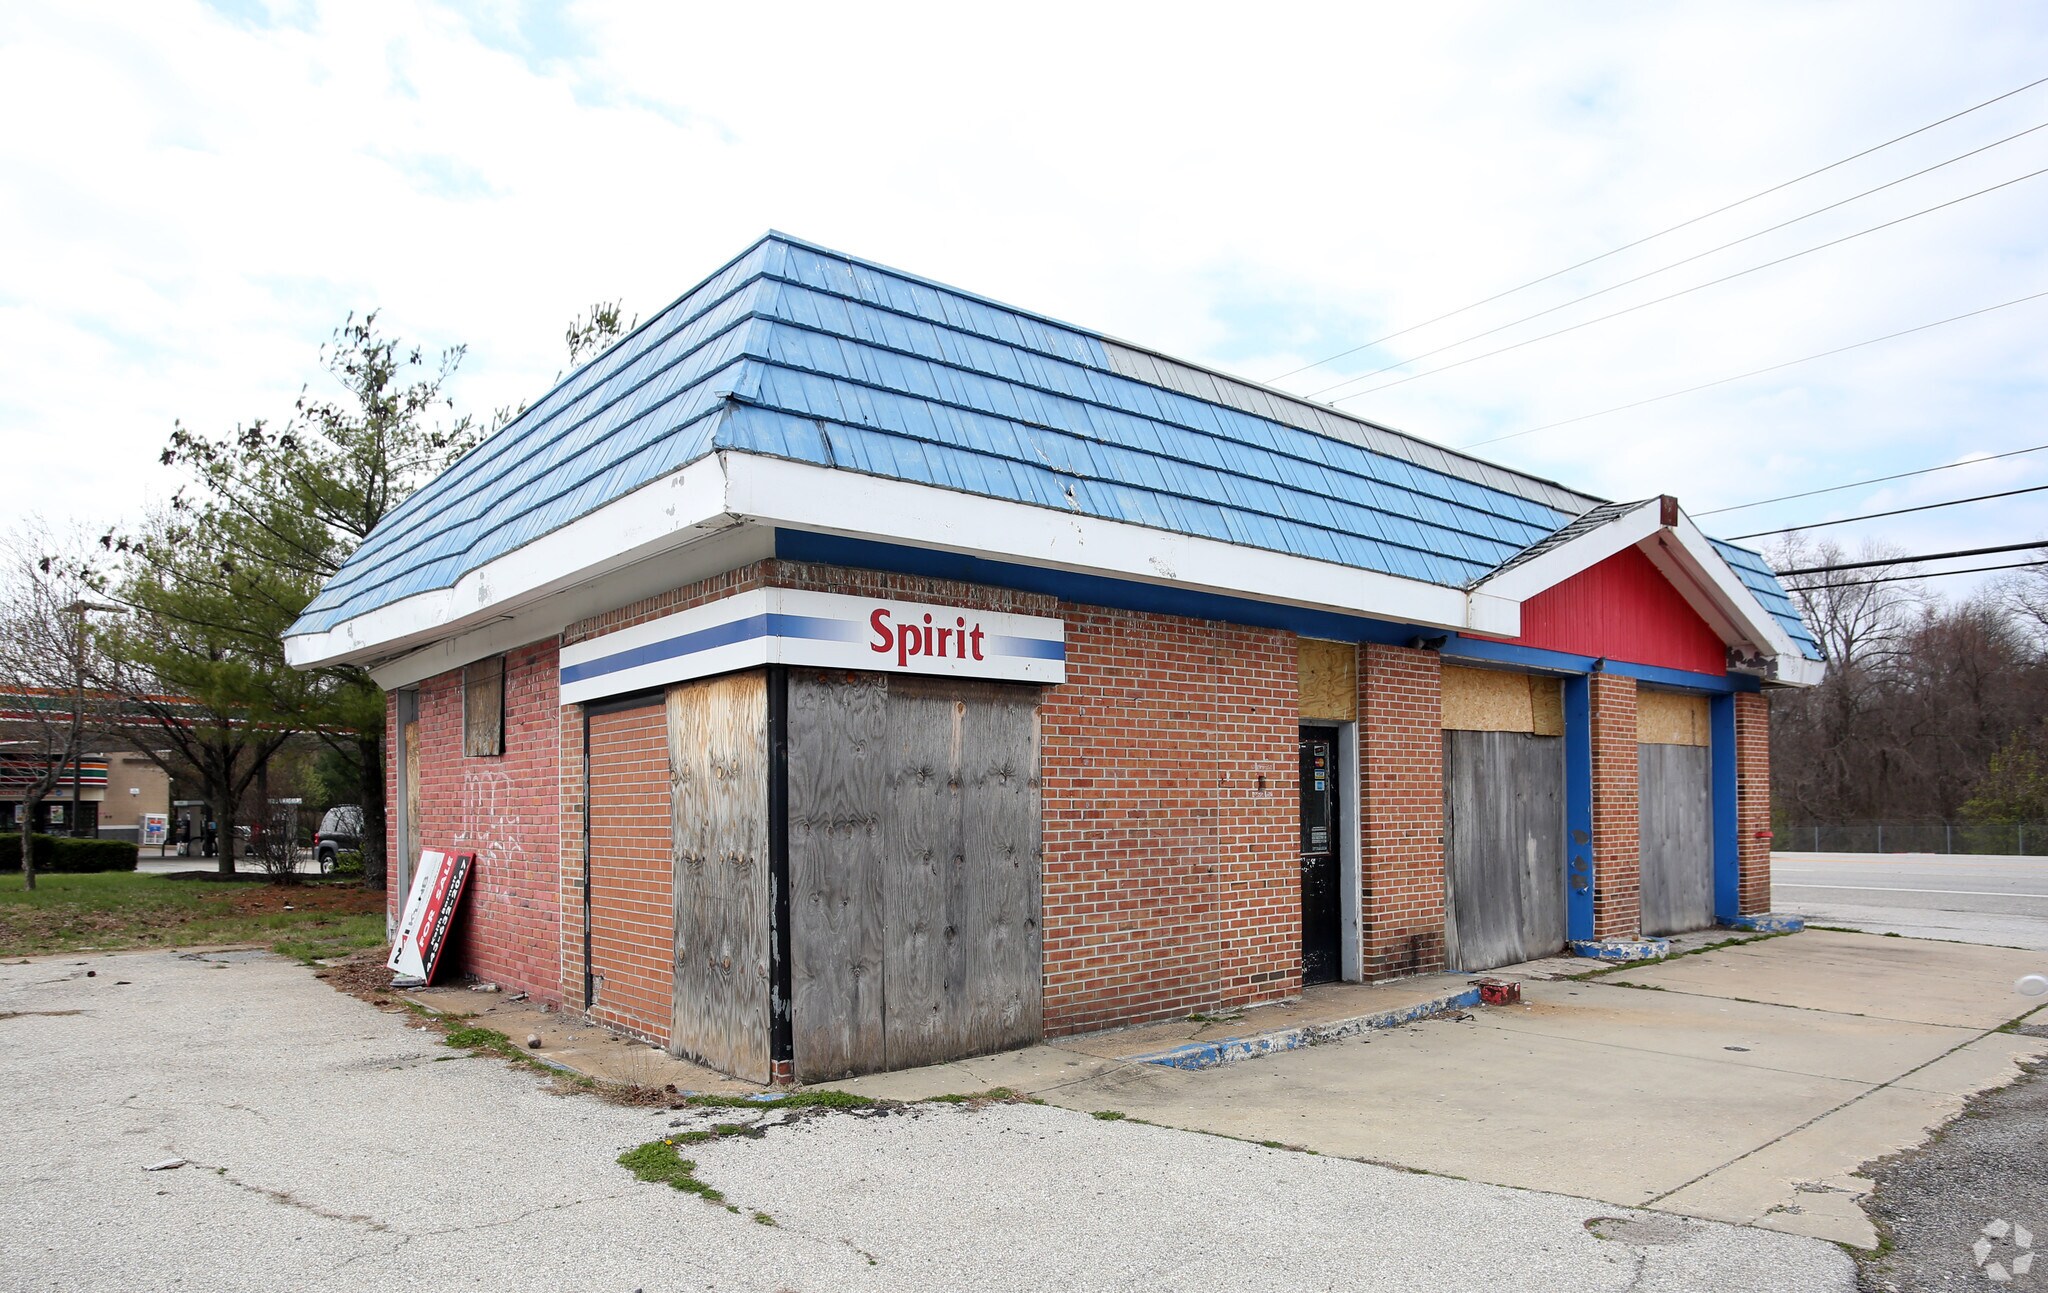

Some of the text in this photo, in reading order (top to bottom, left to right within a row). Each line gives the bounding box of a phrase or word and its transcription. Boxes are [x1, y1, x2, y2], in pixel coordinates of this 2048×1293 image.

[870, 608, 985, 667] Spirit
[417, 909, 435, 947] FOR
[434, 856, 454, 900] SALE
